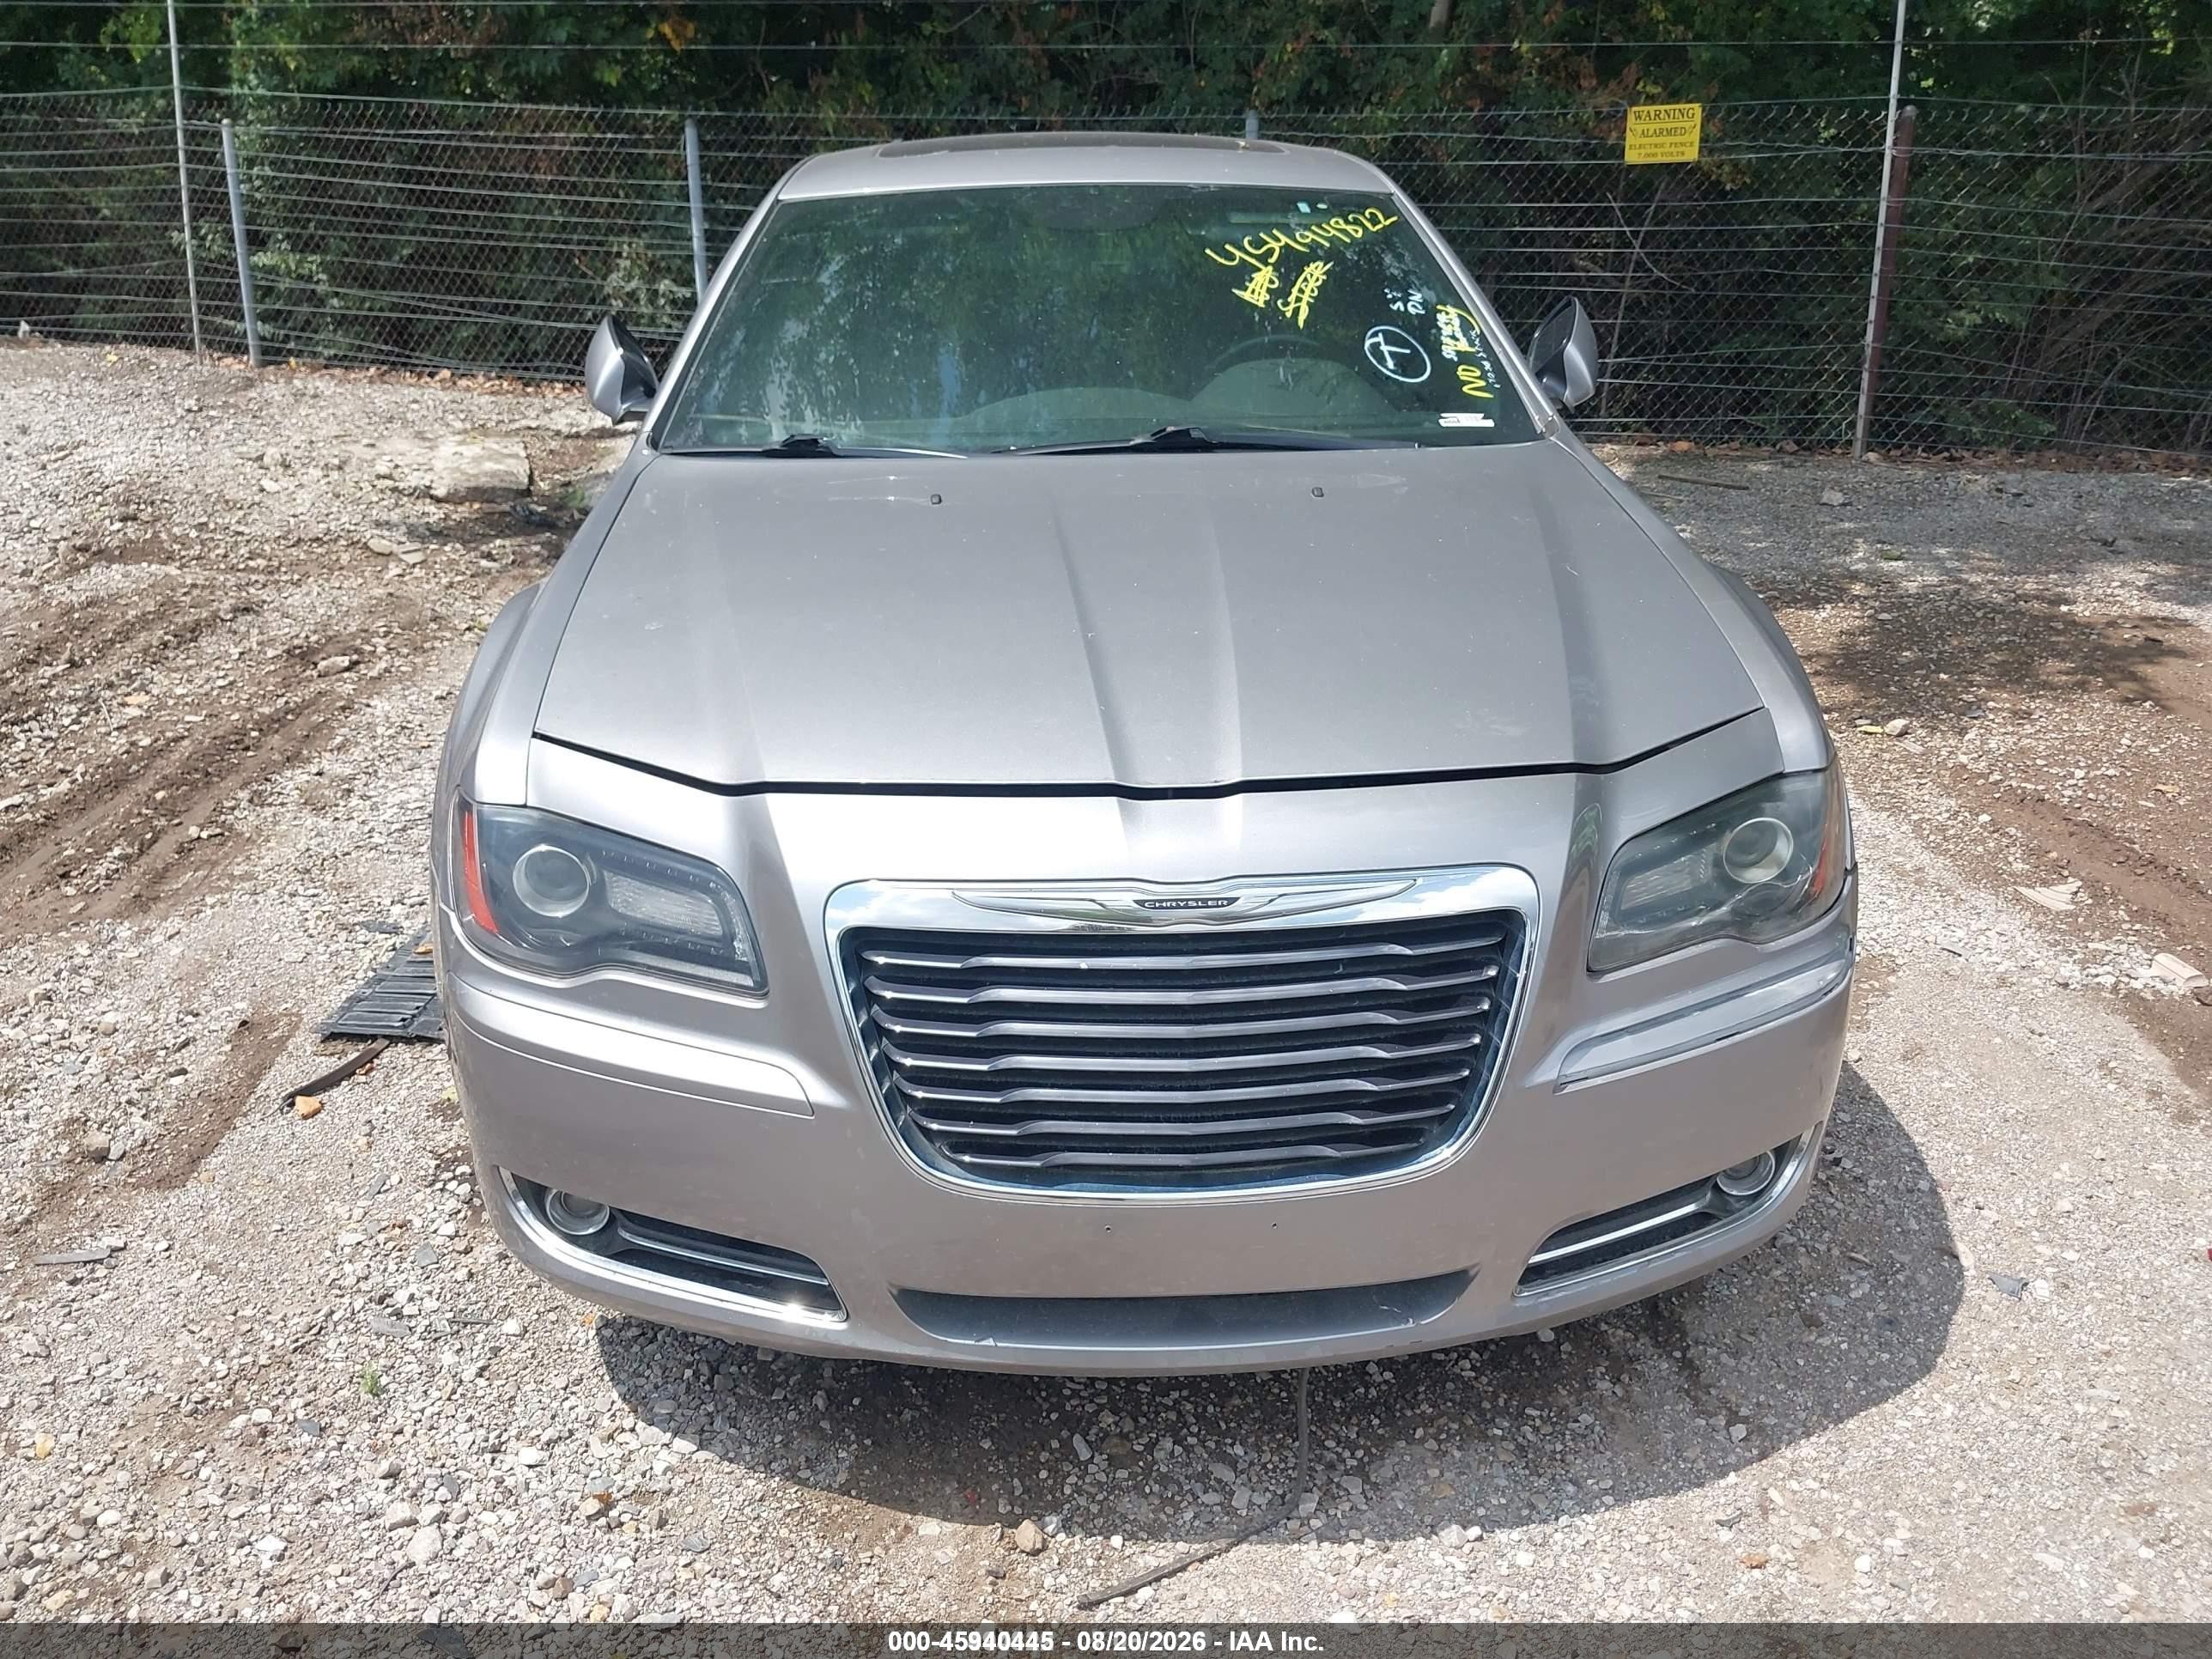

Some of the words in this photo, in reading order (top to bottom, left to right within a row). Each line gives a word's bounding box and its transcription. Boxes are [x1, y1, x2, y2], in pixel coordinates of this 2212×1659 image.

[1633, 107, 1696, 122] WARNING
[1639, 126, 1686, 138] ALARMED
[1144, 899, 1229, 908] CHRYSLER
